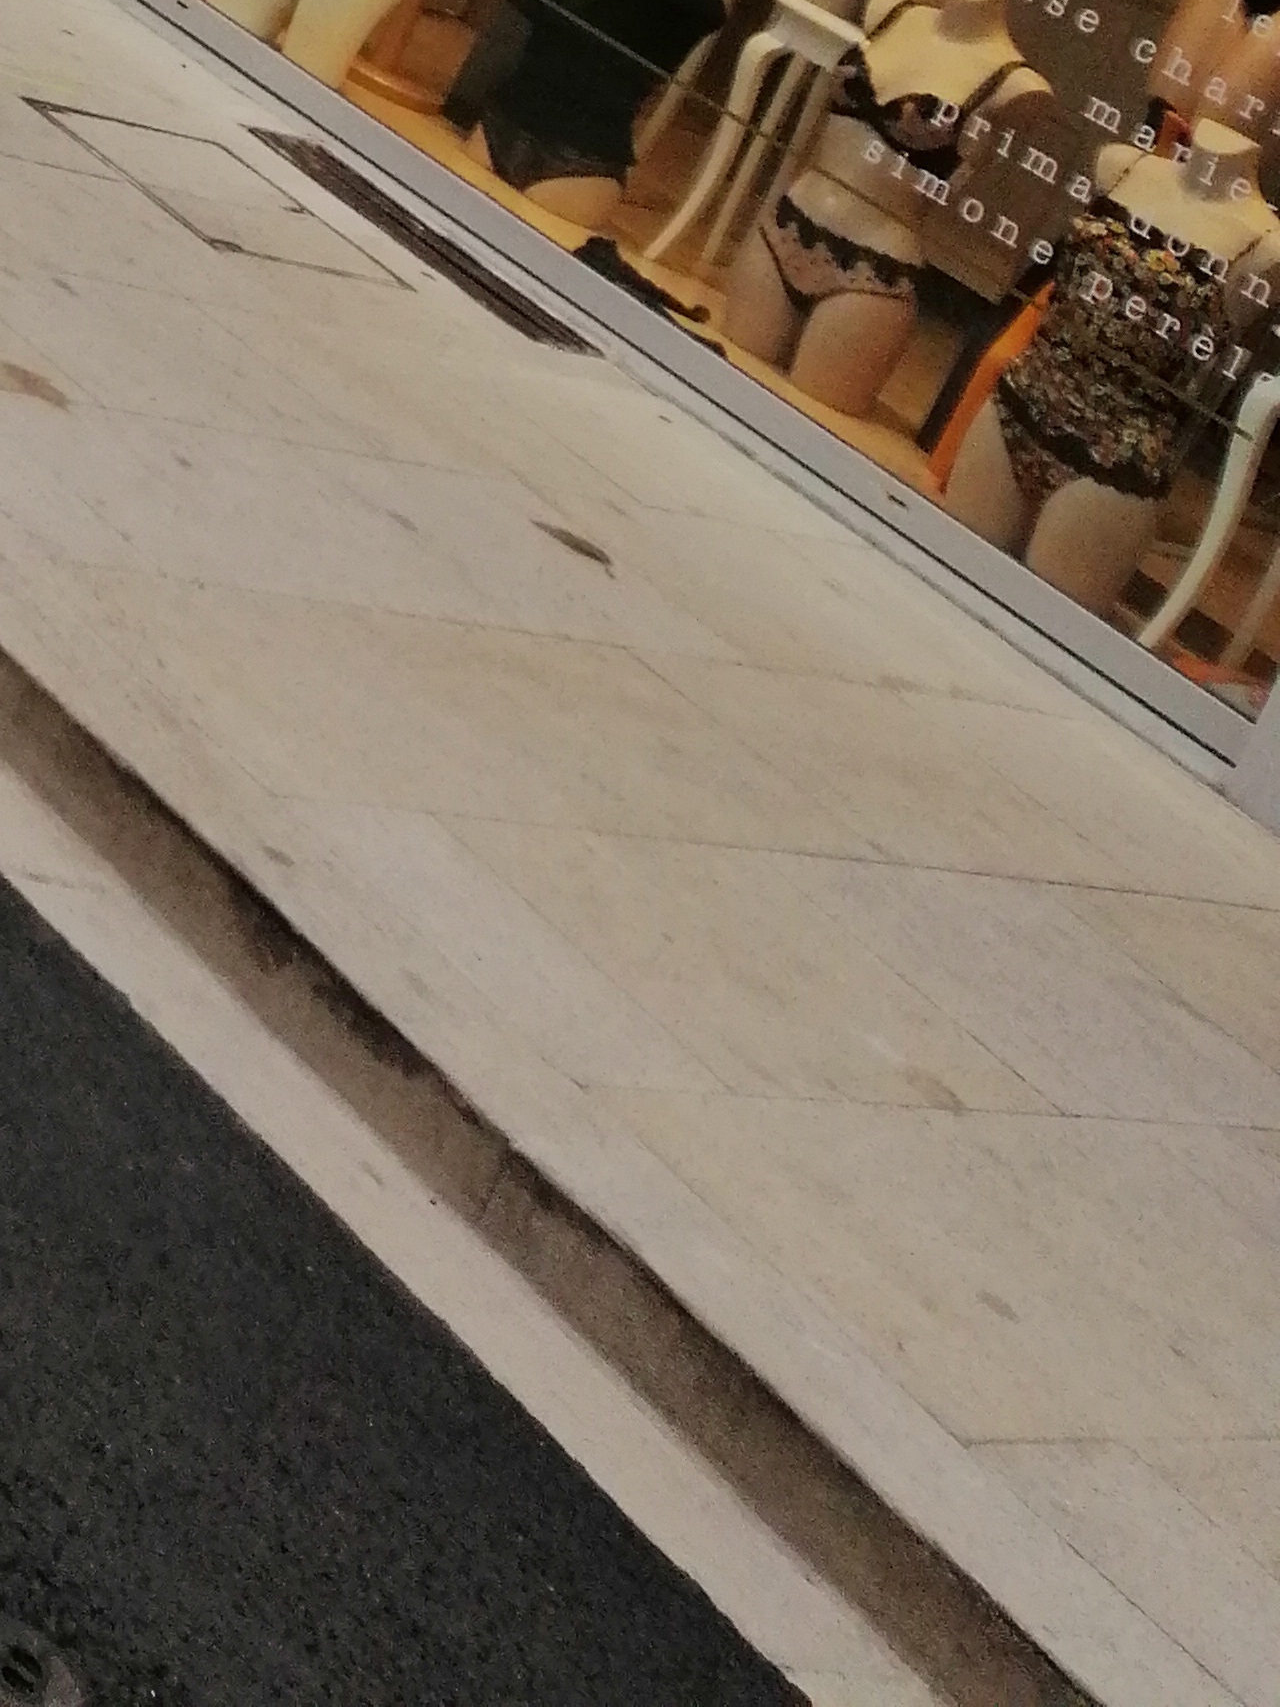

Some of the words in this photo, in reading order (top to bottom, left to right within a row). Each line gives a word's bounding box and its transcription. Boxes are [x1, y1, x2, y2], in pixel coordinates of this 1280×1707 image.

[1134, 37, 1280, 137] char
[861, 137, 1055, 266] simone
[930, 98, 1091, 204] prima
[1130, 210, 1280, 337] donn
